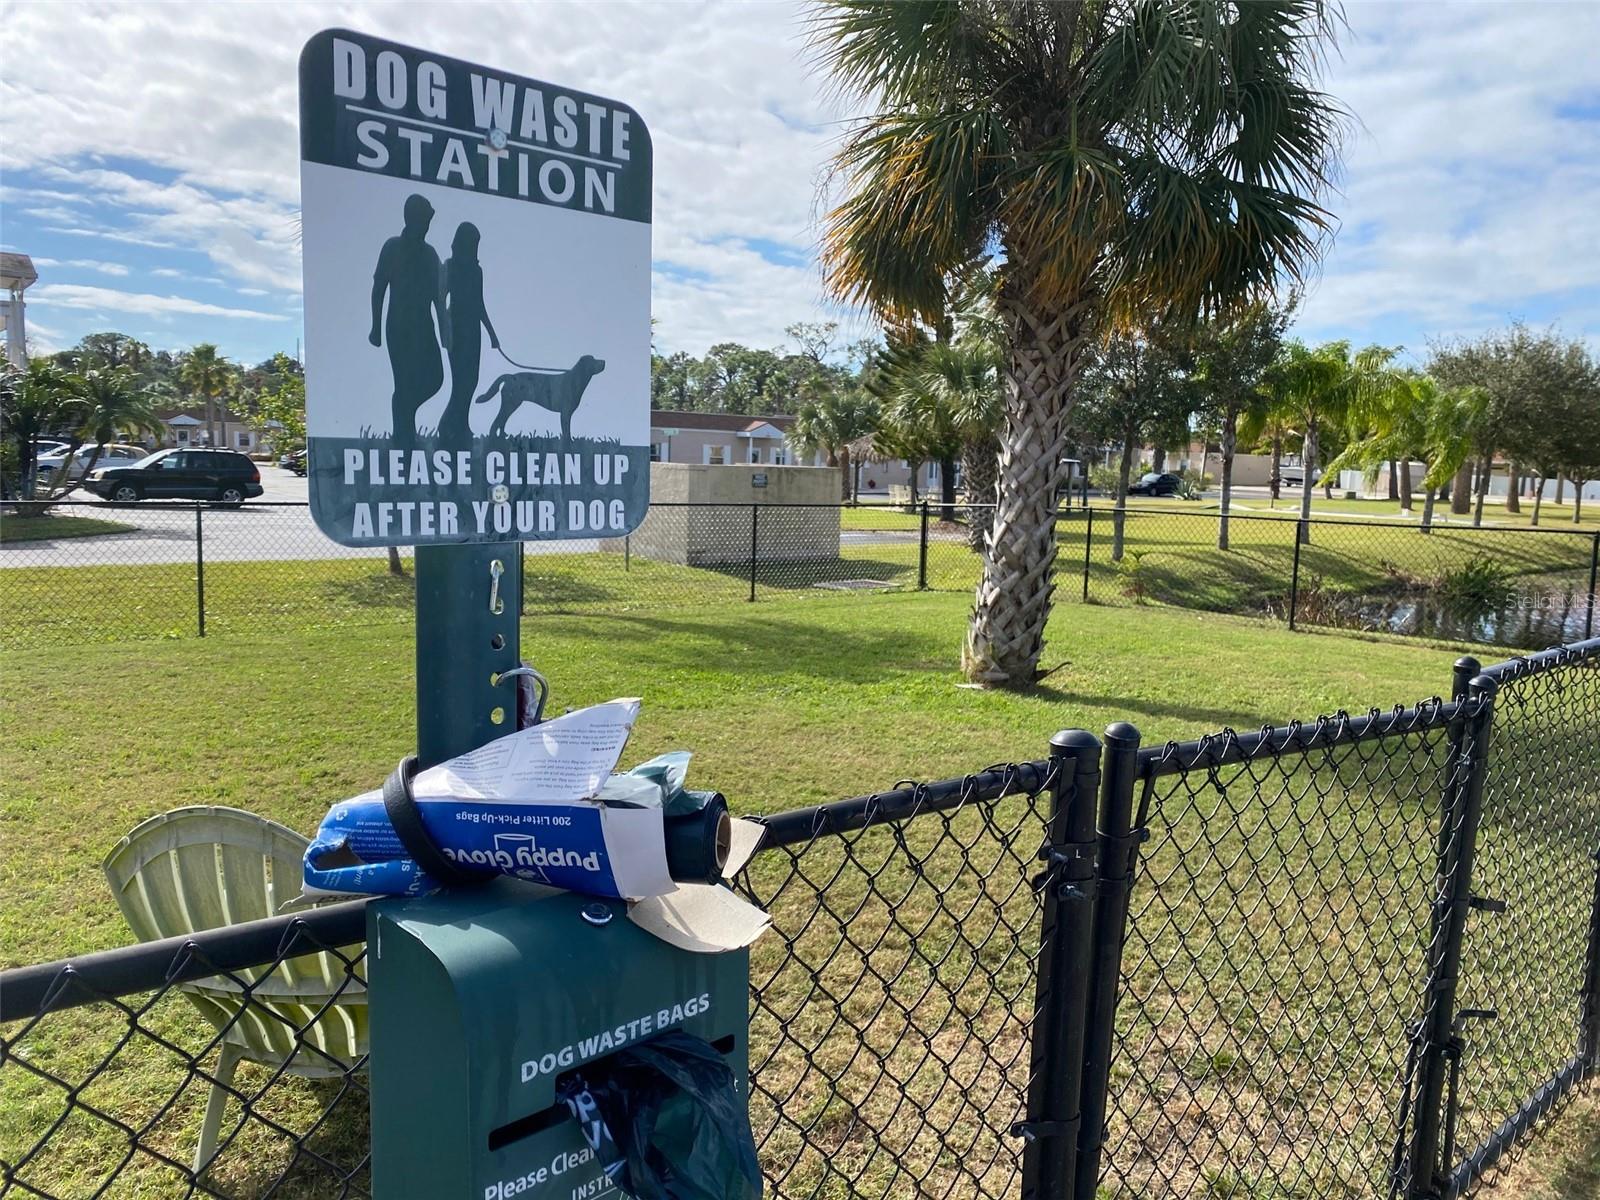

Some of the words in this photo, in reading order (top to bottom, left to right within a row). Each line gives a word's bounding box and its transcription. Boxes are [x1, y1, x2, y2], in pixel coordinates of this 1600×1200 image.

[333, 37, 447, 120] DOG
[470, 73, 630, 161] WASTE
[356, 120, 616, 213] STATION
[343, 448, 472, 486] PLEASE
[486, 451, 583, 486] CLEAN
[593, 453, 630, 486] UP
[352, 501, 459, 538] AFTER
[472, 499, 556, 534] YOUR
[567, 499, 626, 532] DOG
[455, 811, 480, 823] Bags
[481, 812, 520, 825] Pick-Up
[521, 814, 550, 826] Litter
[552, 816, 572, 826] 200
[441, 846, 514, 869] Glove
[515, 845, 601, 872] Puppy
[520, 1045, 574, 1084] DOG
[577, 1014, 652, 1060] WASTE
[656, 992, 711, 1030] BAGS
[484, 1166, 548, 1200] Please
